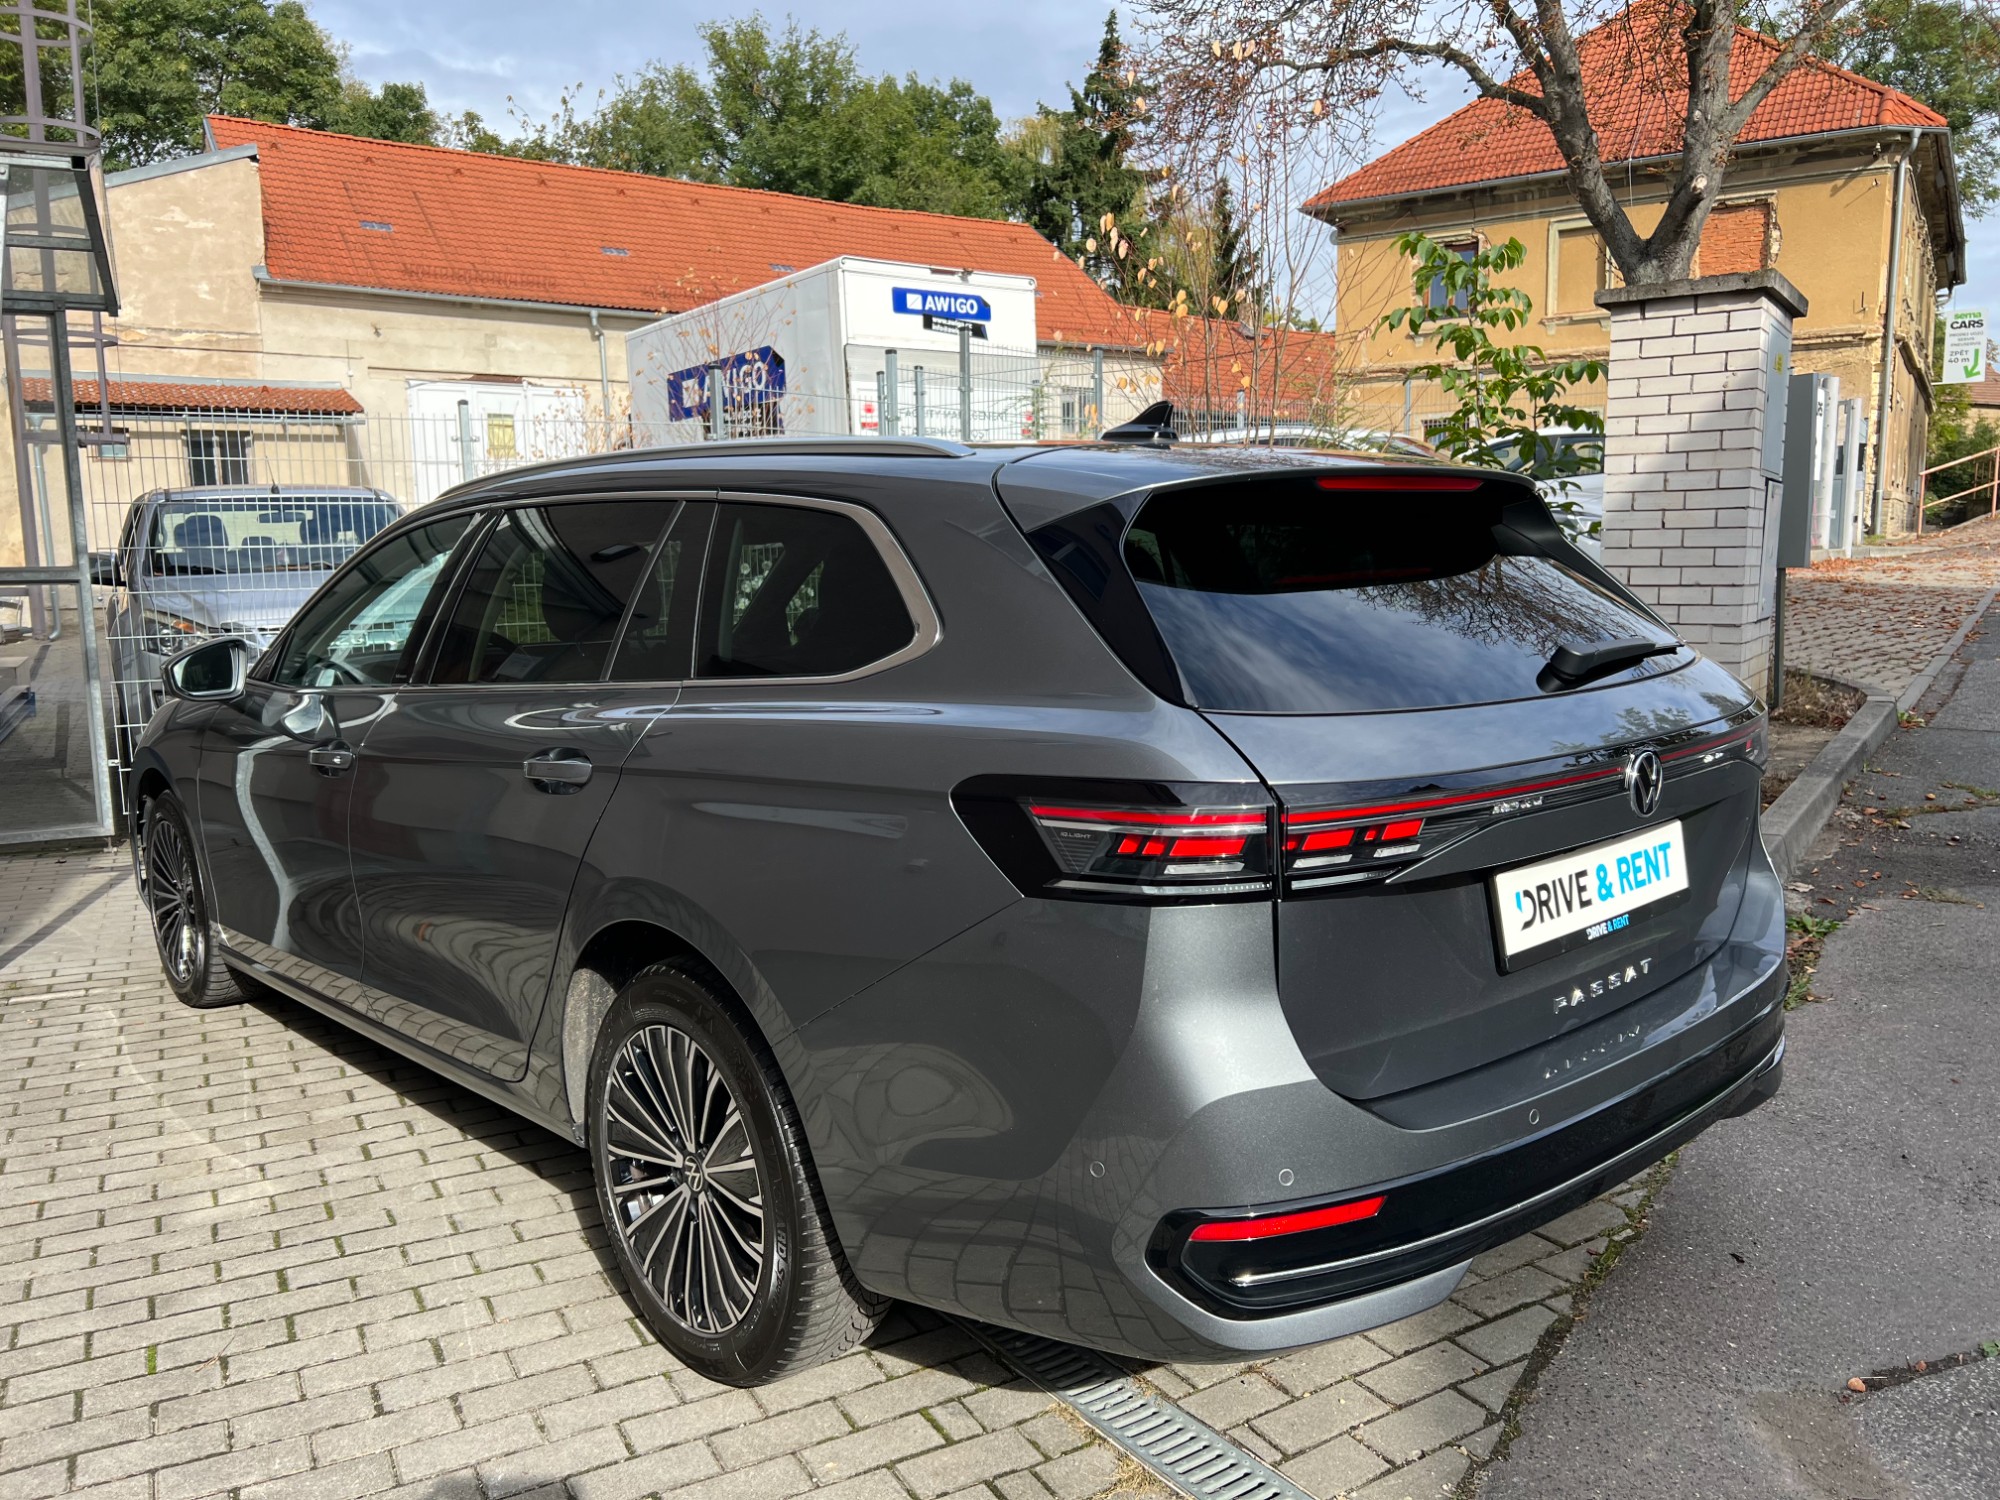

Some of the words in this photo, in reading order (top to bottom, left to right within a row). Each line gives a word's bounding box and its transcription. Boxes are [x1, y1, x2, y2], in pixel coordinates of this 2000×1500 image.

[924, 295, 978, 314] AWIGO
[1950, 319, 1984, 330] CARS
[899, 408, 940, 418] FACITY
[1515, 869, 1593, 931] DRIVE
[1595, 863, 1615, 902] &
[1616, 841, 1671, 895] RENT
[1586, 922, 1608, 940] DRIVE
[1607, 920, 1613, 932] &
[1613, 914, 1629, 930] RENT
[1553, 957, 1652, 1014] PASSAT
